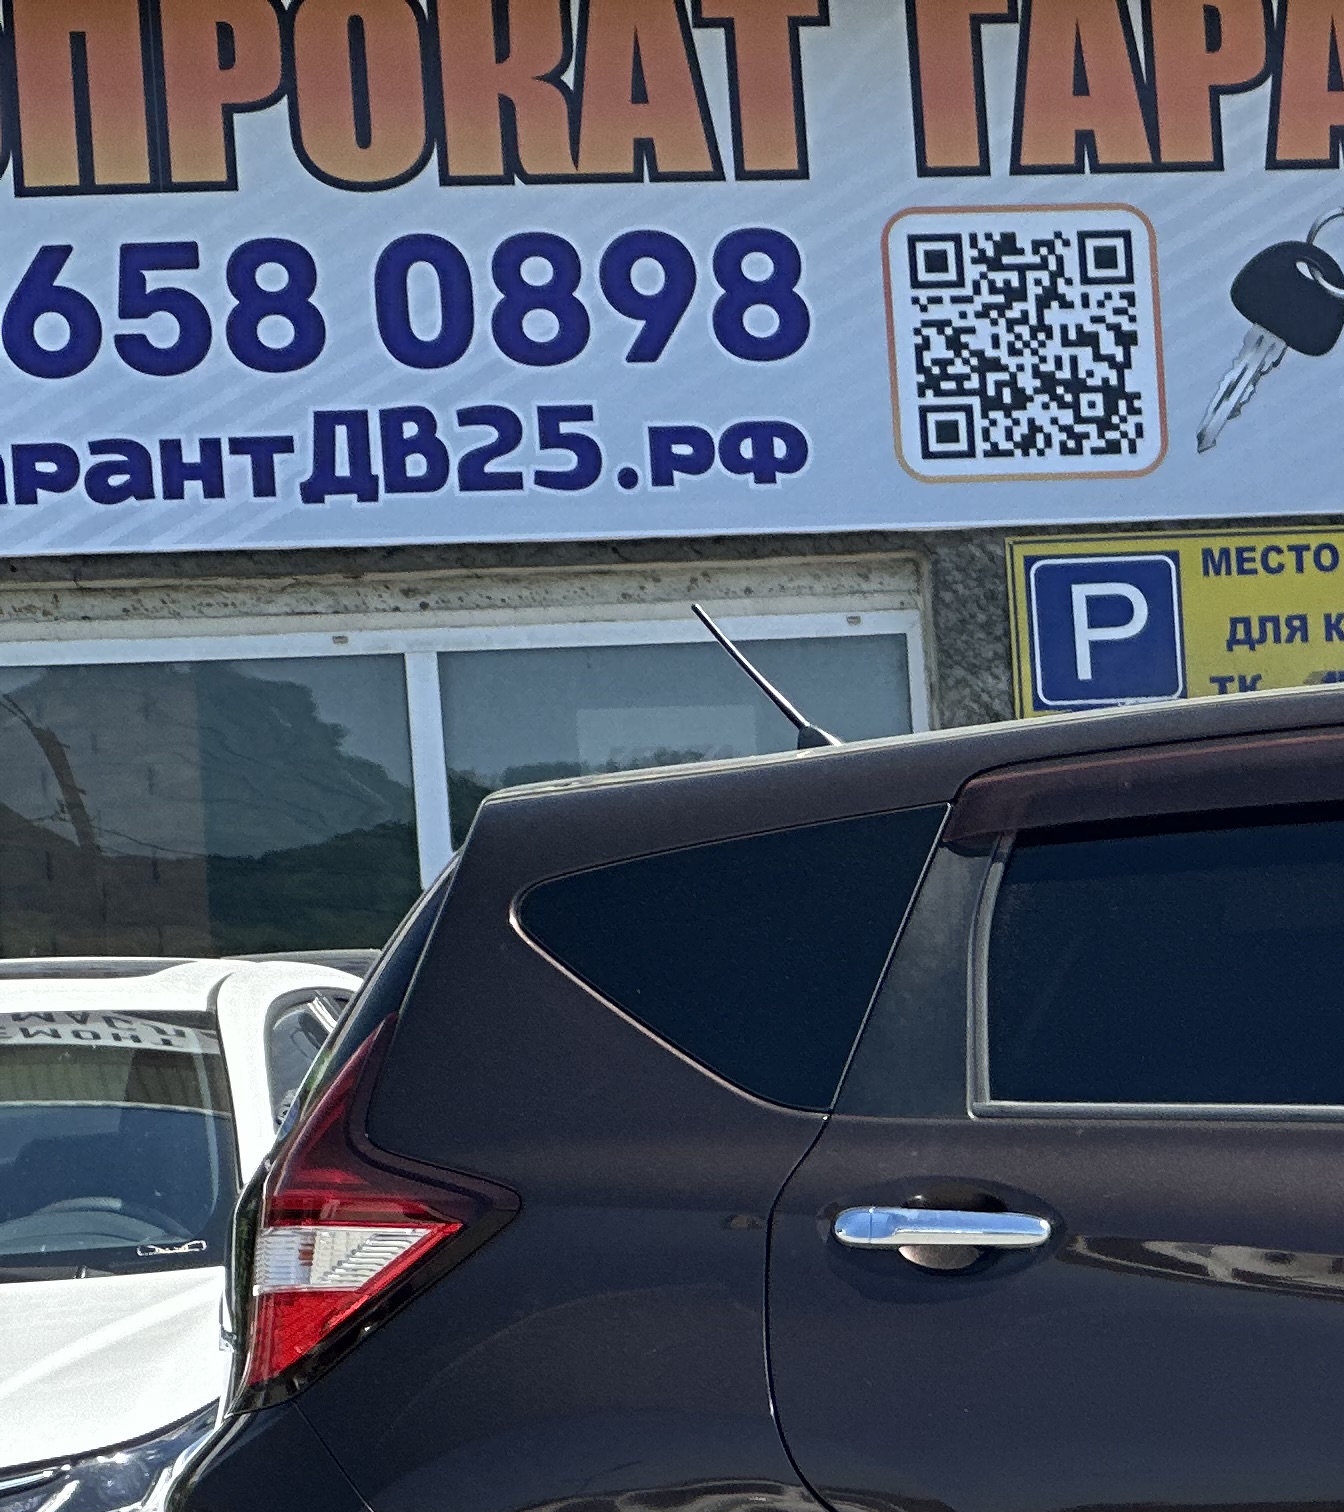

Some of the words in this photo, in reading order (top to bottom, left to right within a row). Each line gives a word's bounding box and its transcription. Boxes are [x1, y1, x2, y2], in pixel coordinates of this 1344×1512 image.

[0, 0, 831, 197] ПРОКАТ
[1, 237, 326, 379] 658
[374, 227, 811, 370] 0898
[0, 404, 809, 505] рантДВ25.рф
[1201, 542, 1340, 578] МЕСТО
[1226, 613, 1310, 653] ДЛЯ
